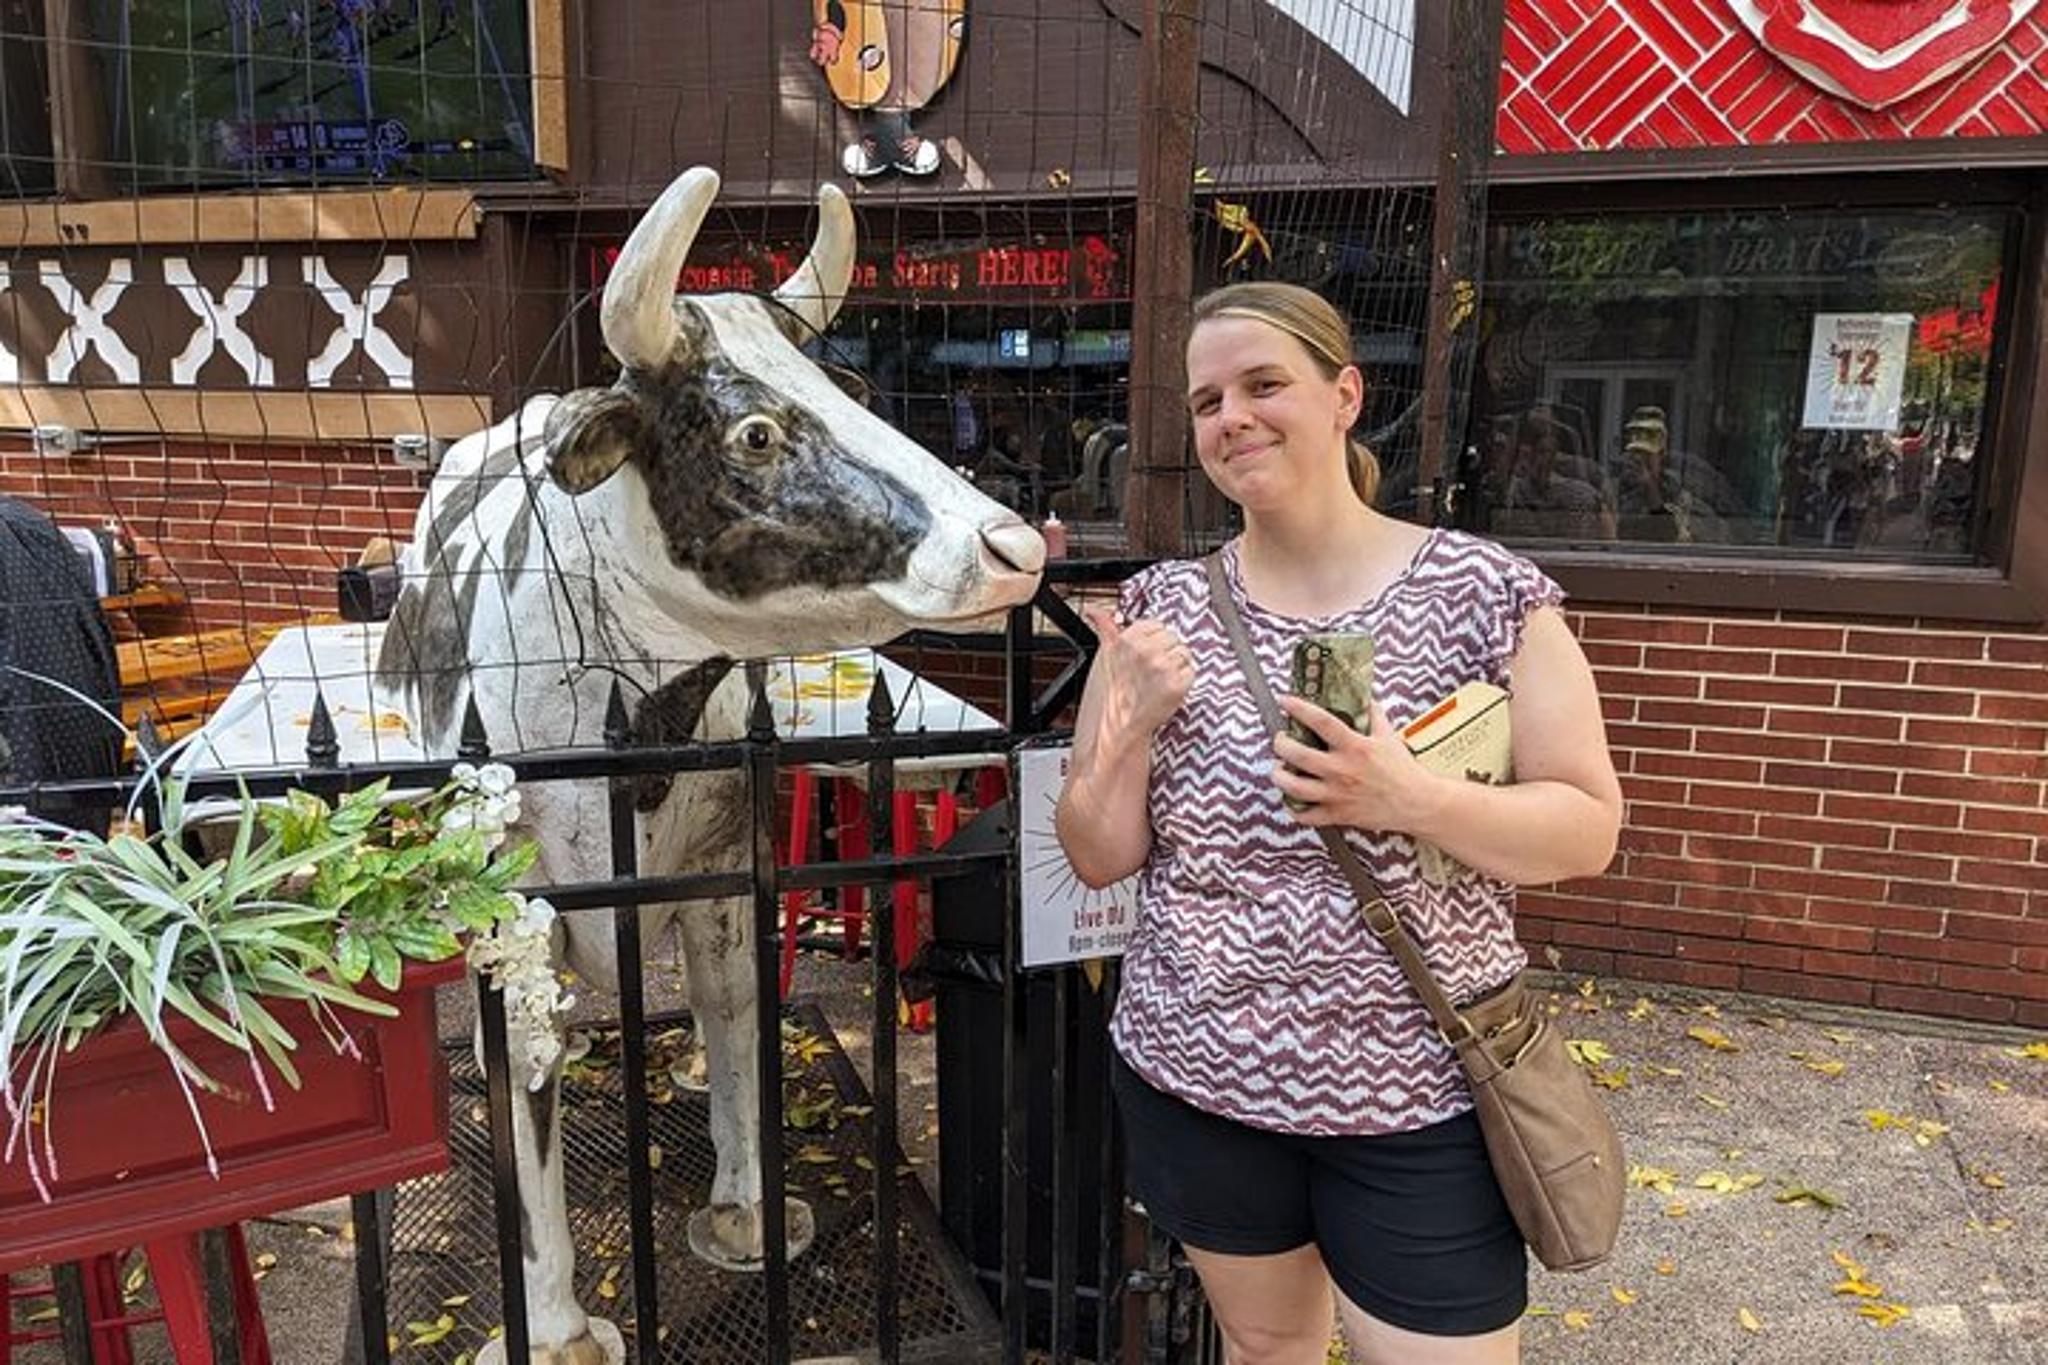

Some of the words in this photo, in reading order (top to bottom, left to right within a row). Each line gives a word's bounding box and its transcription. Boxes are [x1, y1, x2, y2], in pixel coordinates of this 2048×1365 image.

[893, 249, 960, 288] Starts
[976, 249, 1071, 285] HERE!
[1074, 907, 1102, 930] Live
[1106, 905, 1125, 926] DJ
